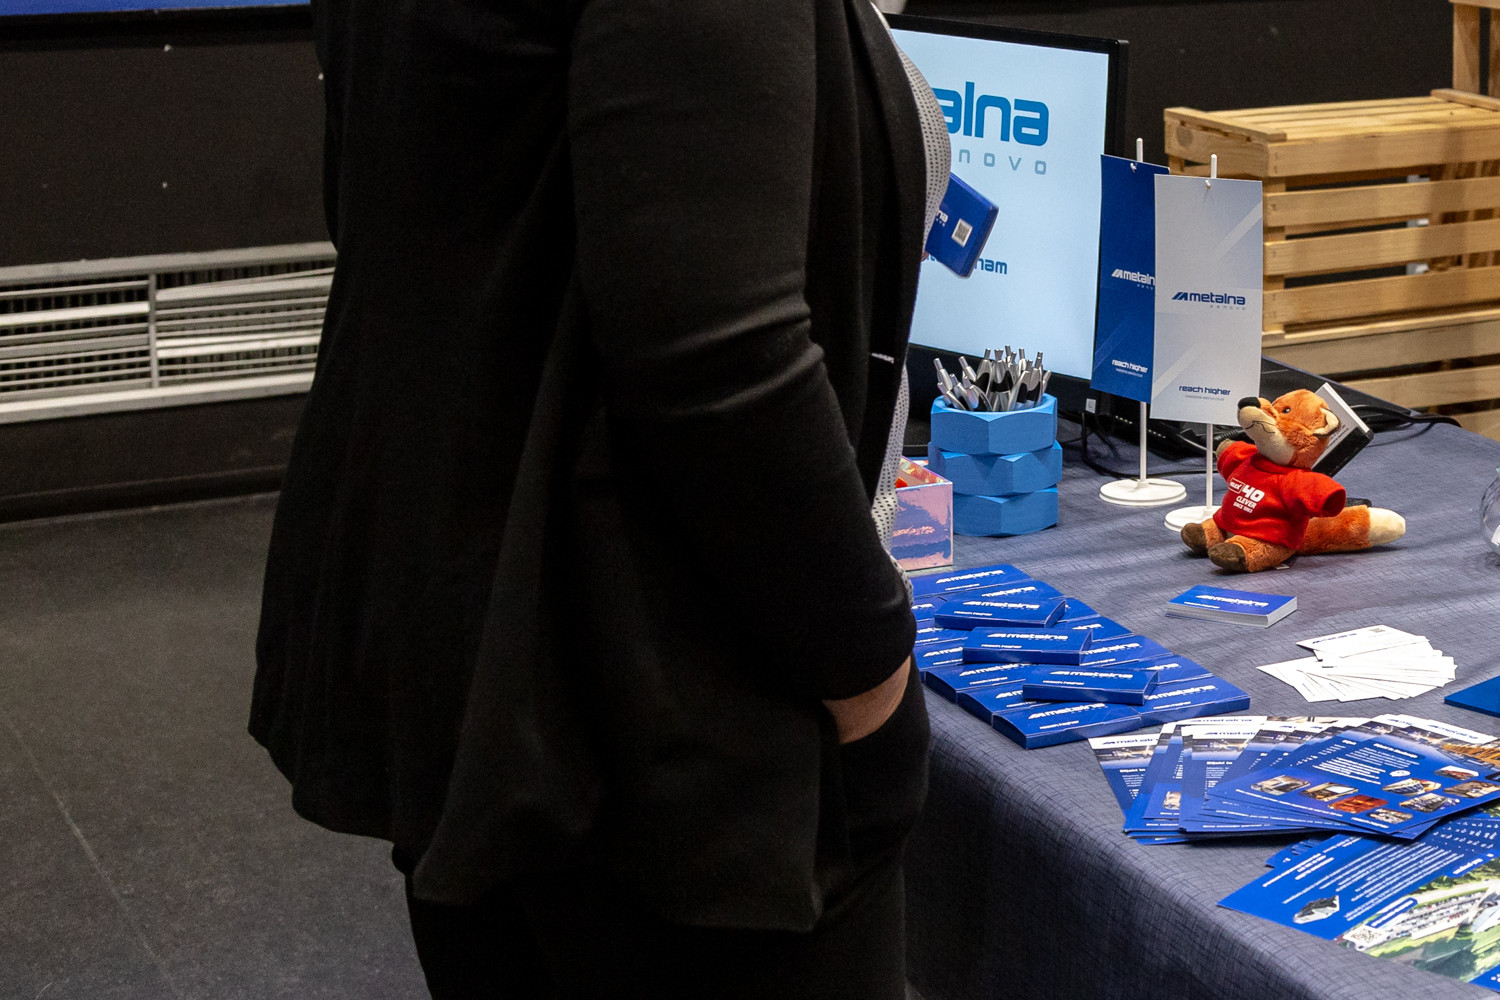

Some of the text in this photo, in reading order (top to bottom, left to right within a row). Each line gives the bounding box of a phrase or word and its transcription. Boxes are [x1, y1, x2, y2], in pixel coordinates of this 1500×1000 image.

[1189, 292, 1247, 306] metalna
[1178, 385, 1231, 397] reach higher
[1241, 484, 1265, 503] 40
